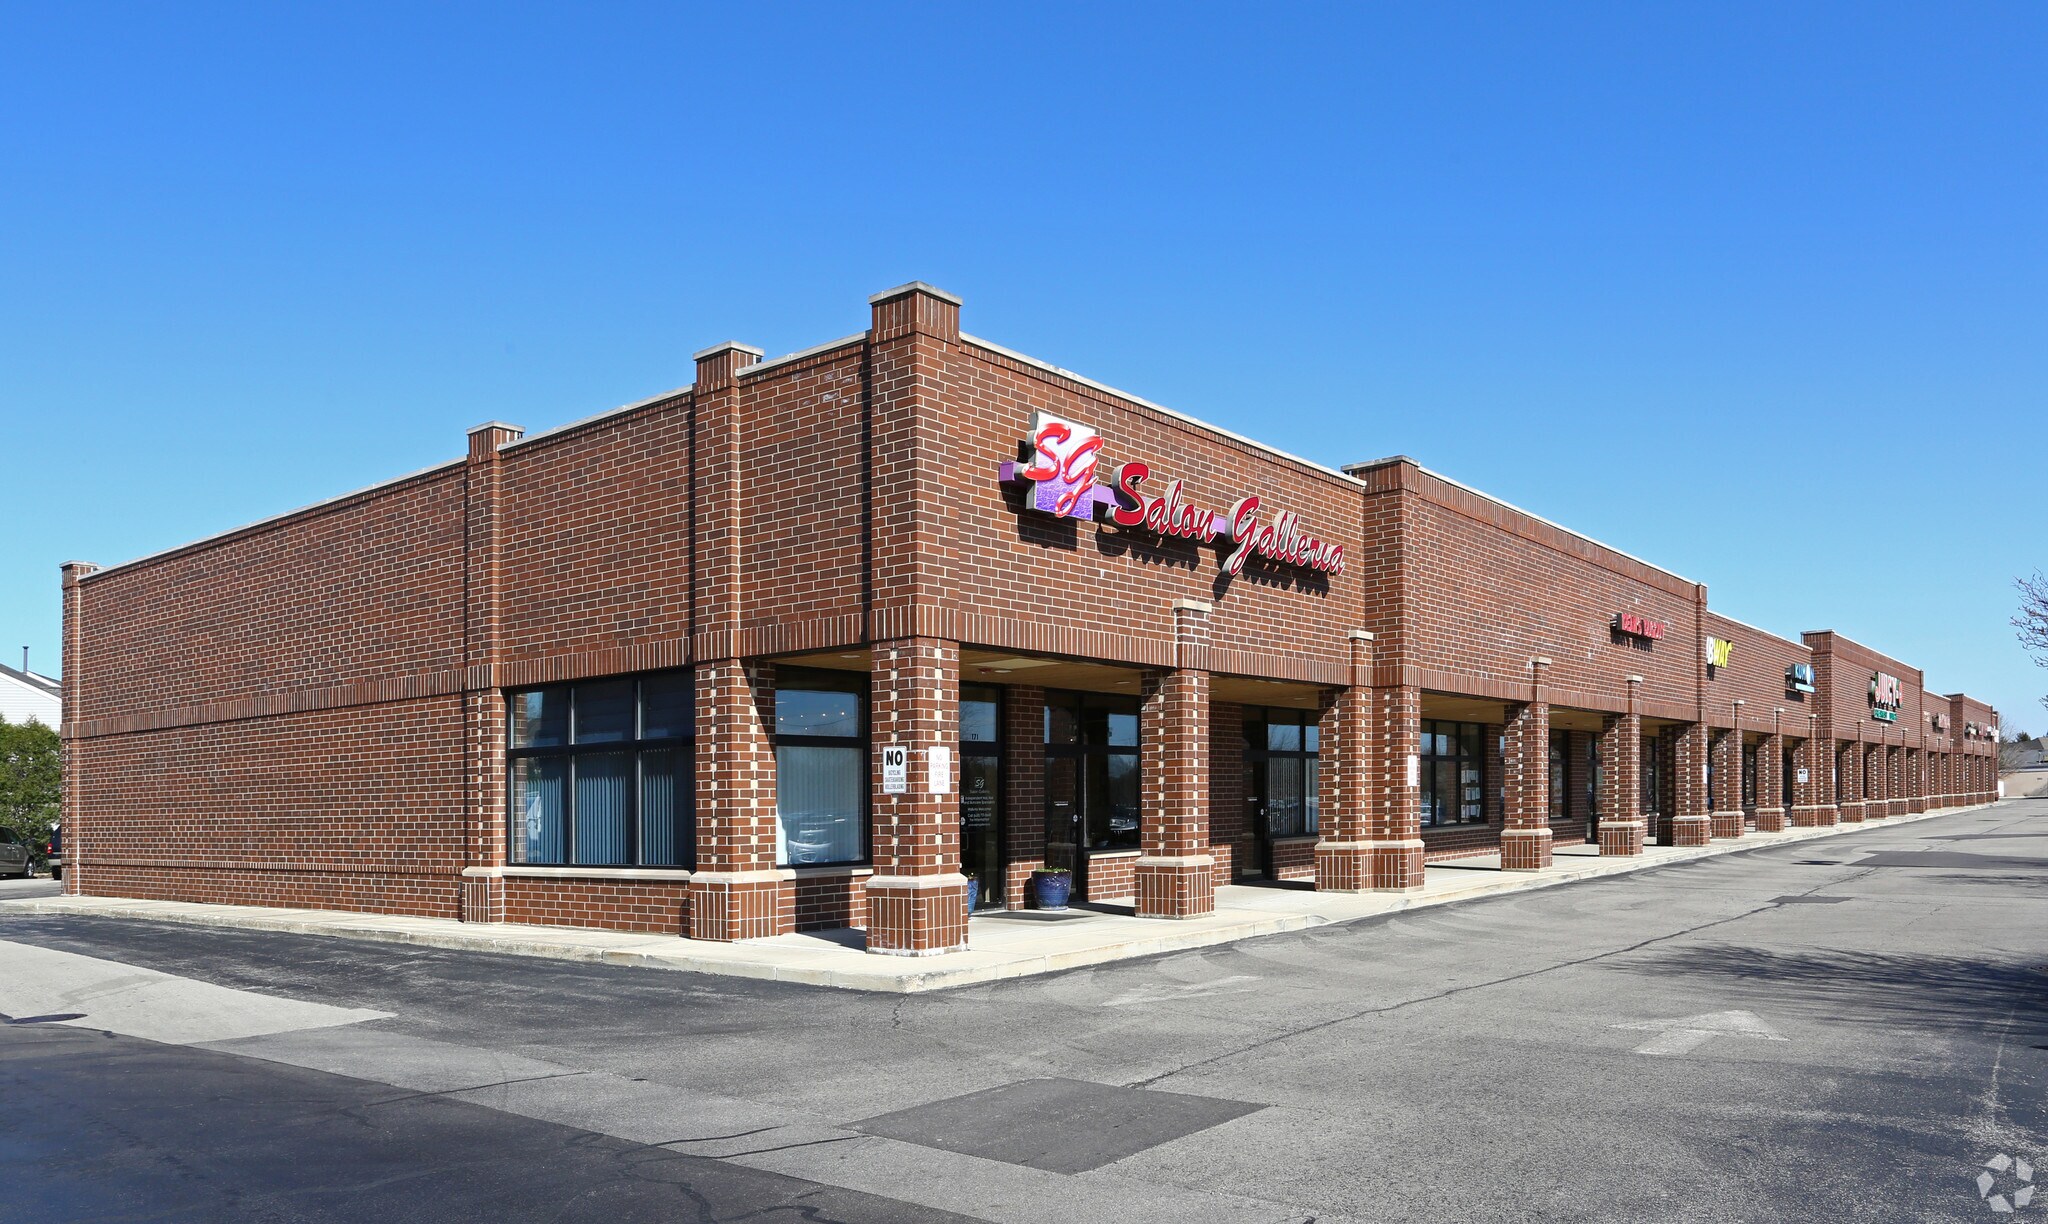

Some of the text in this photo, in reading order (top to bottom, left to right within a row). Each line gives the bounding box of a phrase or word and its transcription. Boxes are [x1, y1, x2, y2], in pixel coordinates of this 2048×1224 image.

[1022, 422, 1104, 518] SG
[1106, 463, 1346, 576] Salon Galleria
[1706, 636, 1733, 668] BWAY
[886, 750, 903, 766] NO
